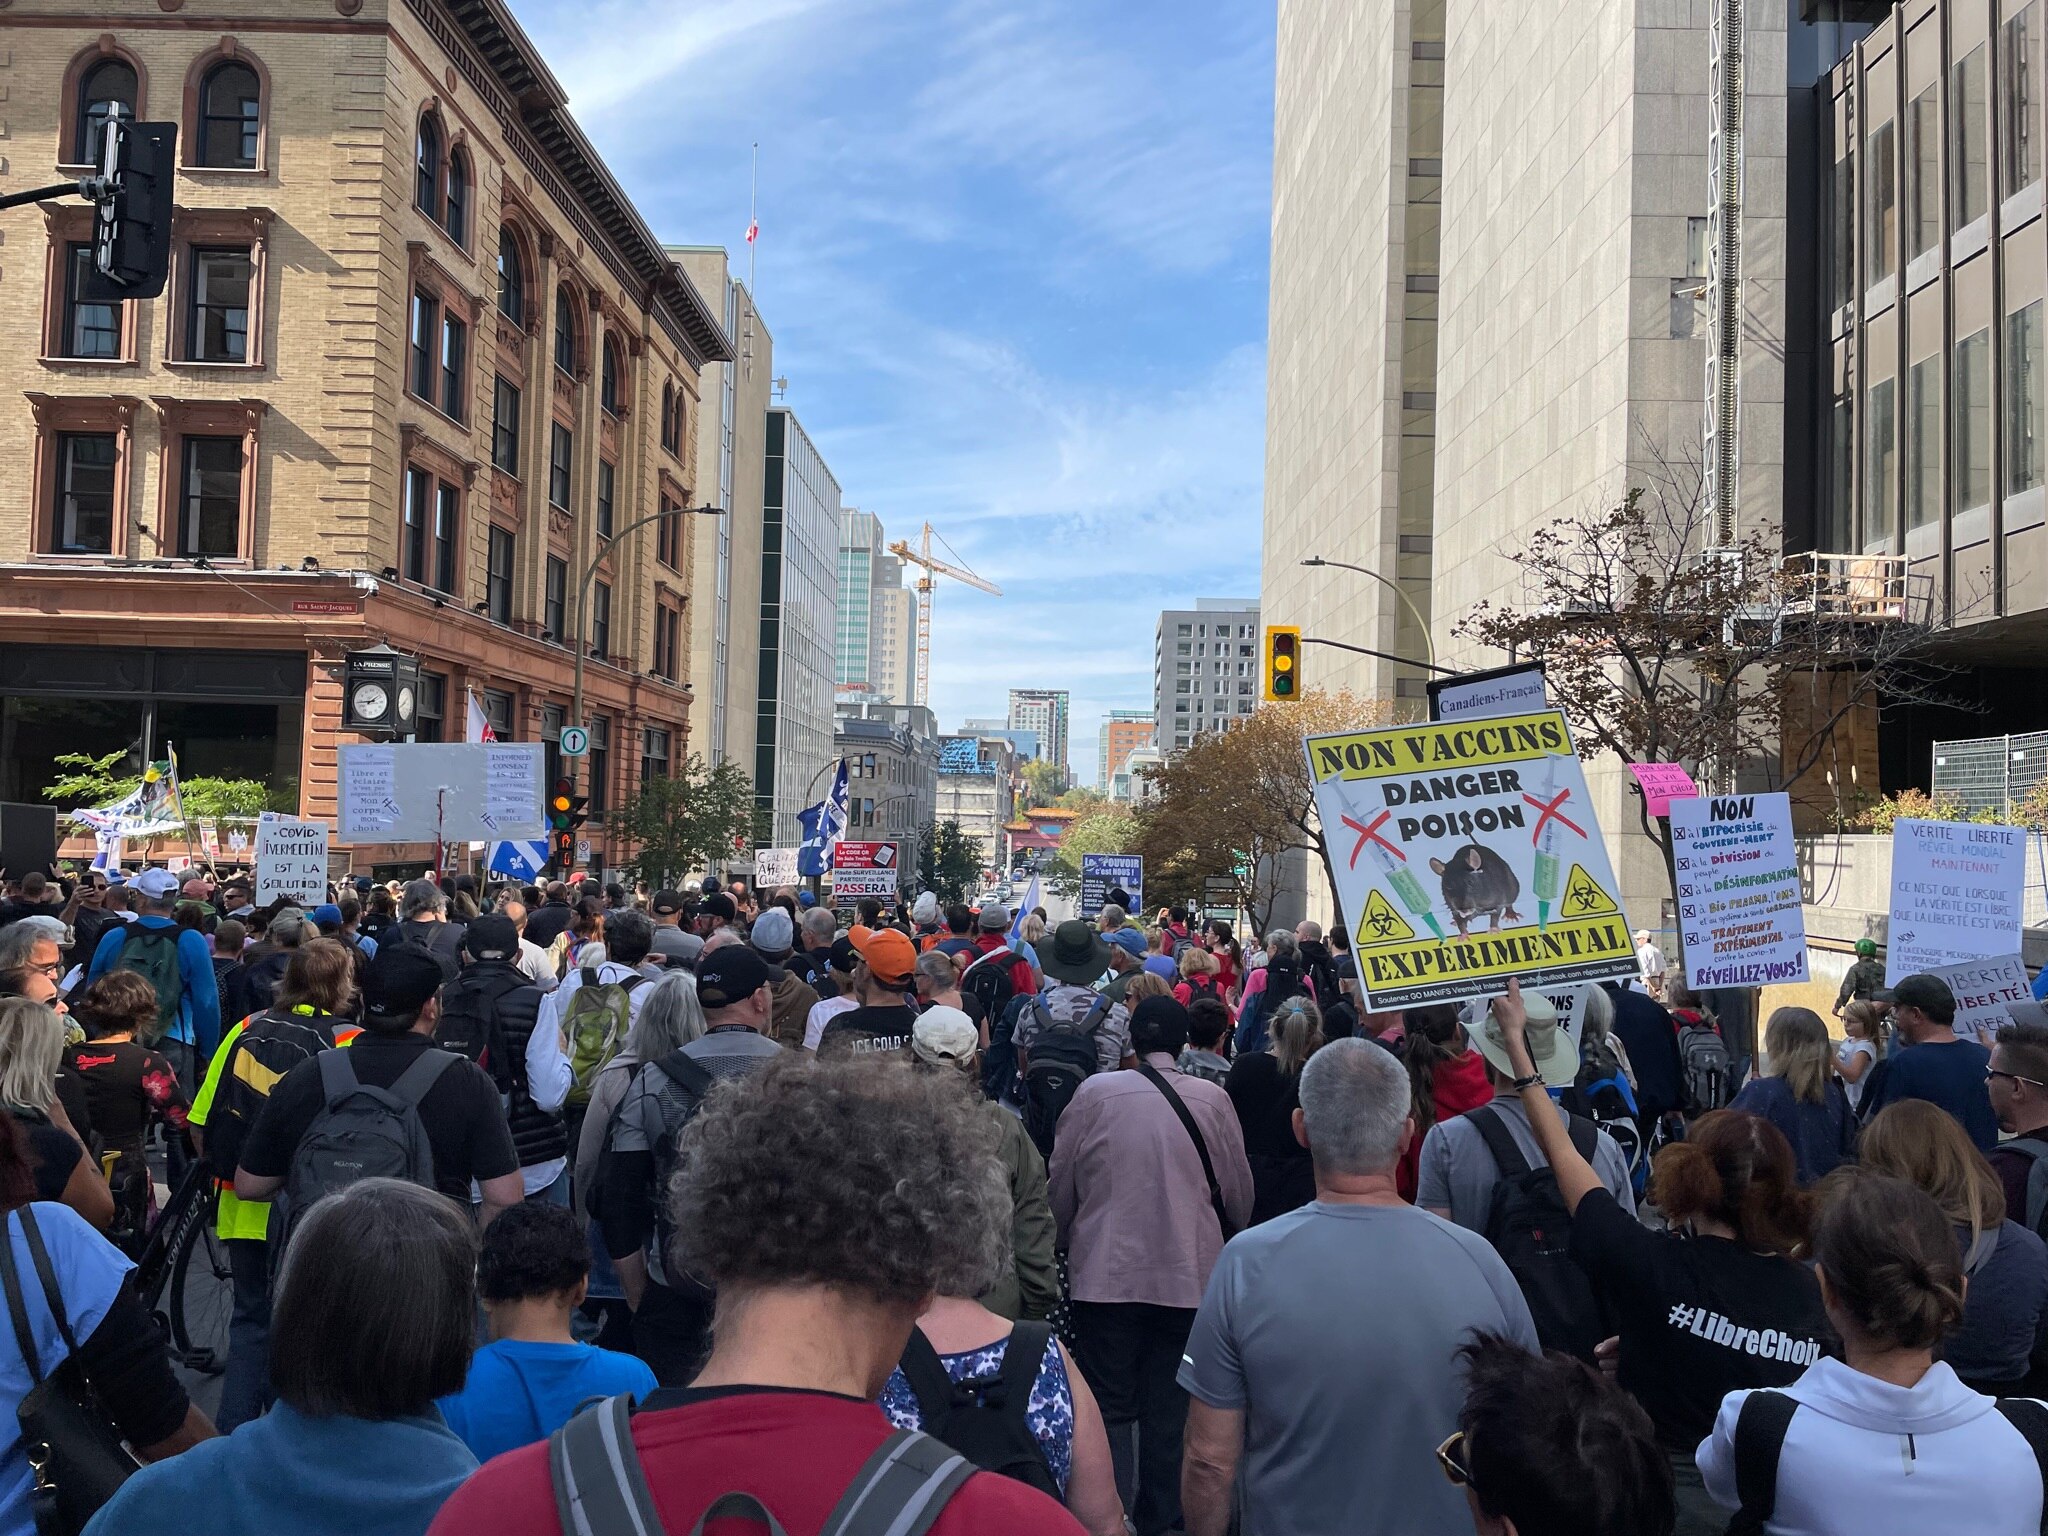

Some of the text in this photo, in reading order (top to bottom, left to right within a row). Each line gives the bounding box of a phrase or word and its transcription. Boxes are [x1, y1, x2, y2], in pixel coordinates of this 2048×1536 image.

[1318, 721, 1562, 775] NON VACCINS
[1381, 769, 1523, 807] DANGER
[1671, 784, 1693, 793] CHOIX
[361, 797, 378, 805] Mon
[1710, 796, 1755, 821] NON
[1397, 804, 1526, 842] POISON
[1962, 844, 2007, 859] MONDIAL
[275, 863, 320, 873] EST LA
[1699, 857, 1707, 866] la
[1931, 858, 2000, 874] MAINTENANT
[759, 874, 797, 885] QUÉBEC
[1694, 867, 1719, 880] peuple
[261, 877, 322, 890] SOLUTION
[835, 884, 886, 893] PASSERA
[1703, 884, 1712, 894] la
[1898, 881, 1910, 893] CE
[1942, 885, 1960, 897] QUE
[1965, 887, 2009, 901] LORSQUE
[1915, 897, 1927, 908] LA
[1965, 901, 1982, 913] EST
[1984, 903, 2013, 916] LIBRE
[1700, 918, 1707, 926] et
[1894, 909, 1912, 921] QUE
[1914, 912, 1926, 922] LA
[1971, 916, 1989, 929] EST
[1992, 919, 2020, 933] VRAIE
[1897, 930, 1916, 943] NON
[1368, 924, 1627, 983] EXPÉRIMENTAL
[1714, 954, 1737, 963] contre
[1738, 951, 1744, 959] la
[1897, 963, 1911, 971] LES
[1947, 960, 2022, 991] IBERTÉ!
[1377, 993, 1410, 1005] Soutenez
[1410, 990, 1423, 999] GO
[1423, 986, 1452, 998] MANIFS
[1452, 981, 1483, 993] Virement
[1483, 980, 1507, 989] Interac
[1957, 982, 2030, 1011] IBERTÉ!
[852, 1038, 870, 1054] ICE
[873, 1035, 901, 1051] COLD
